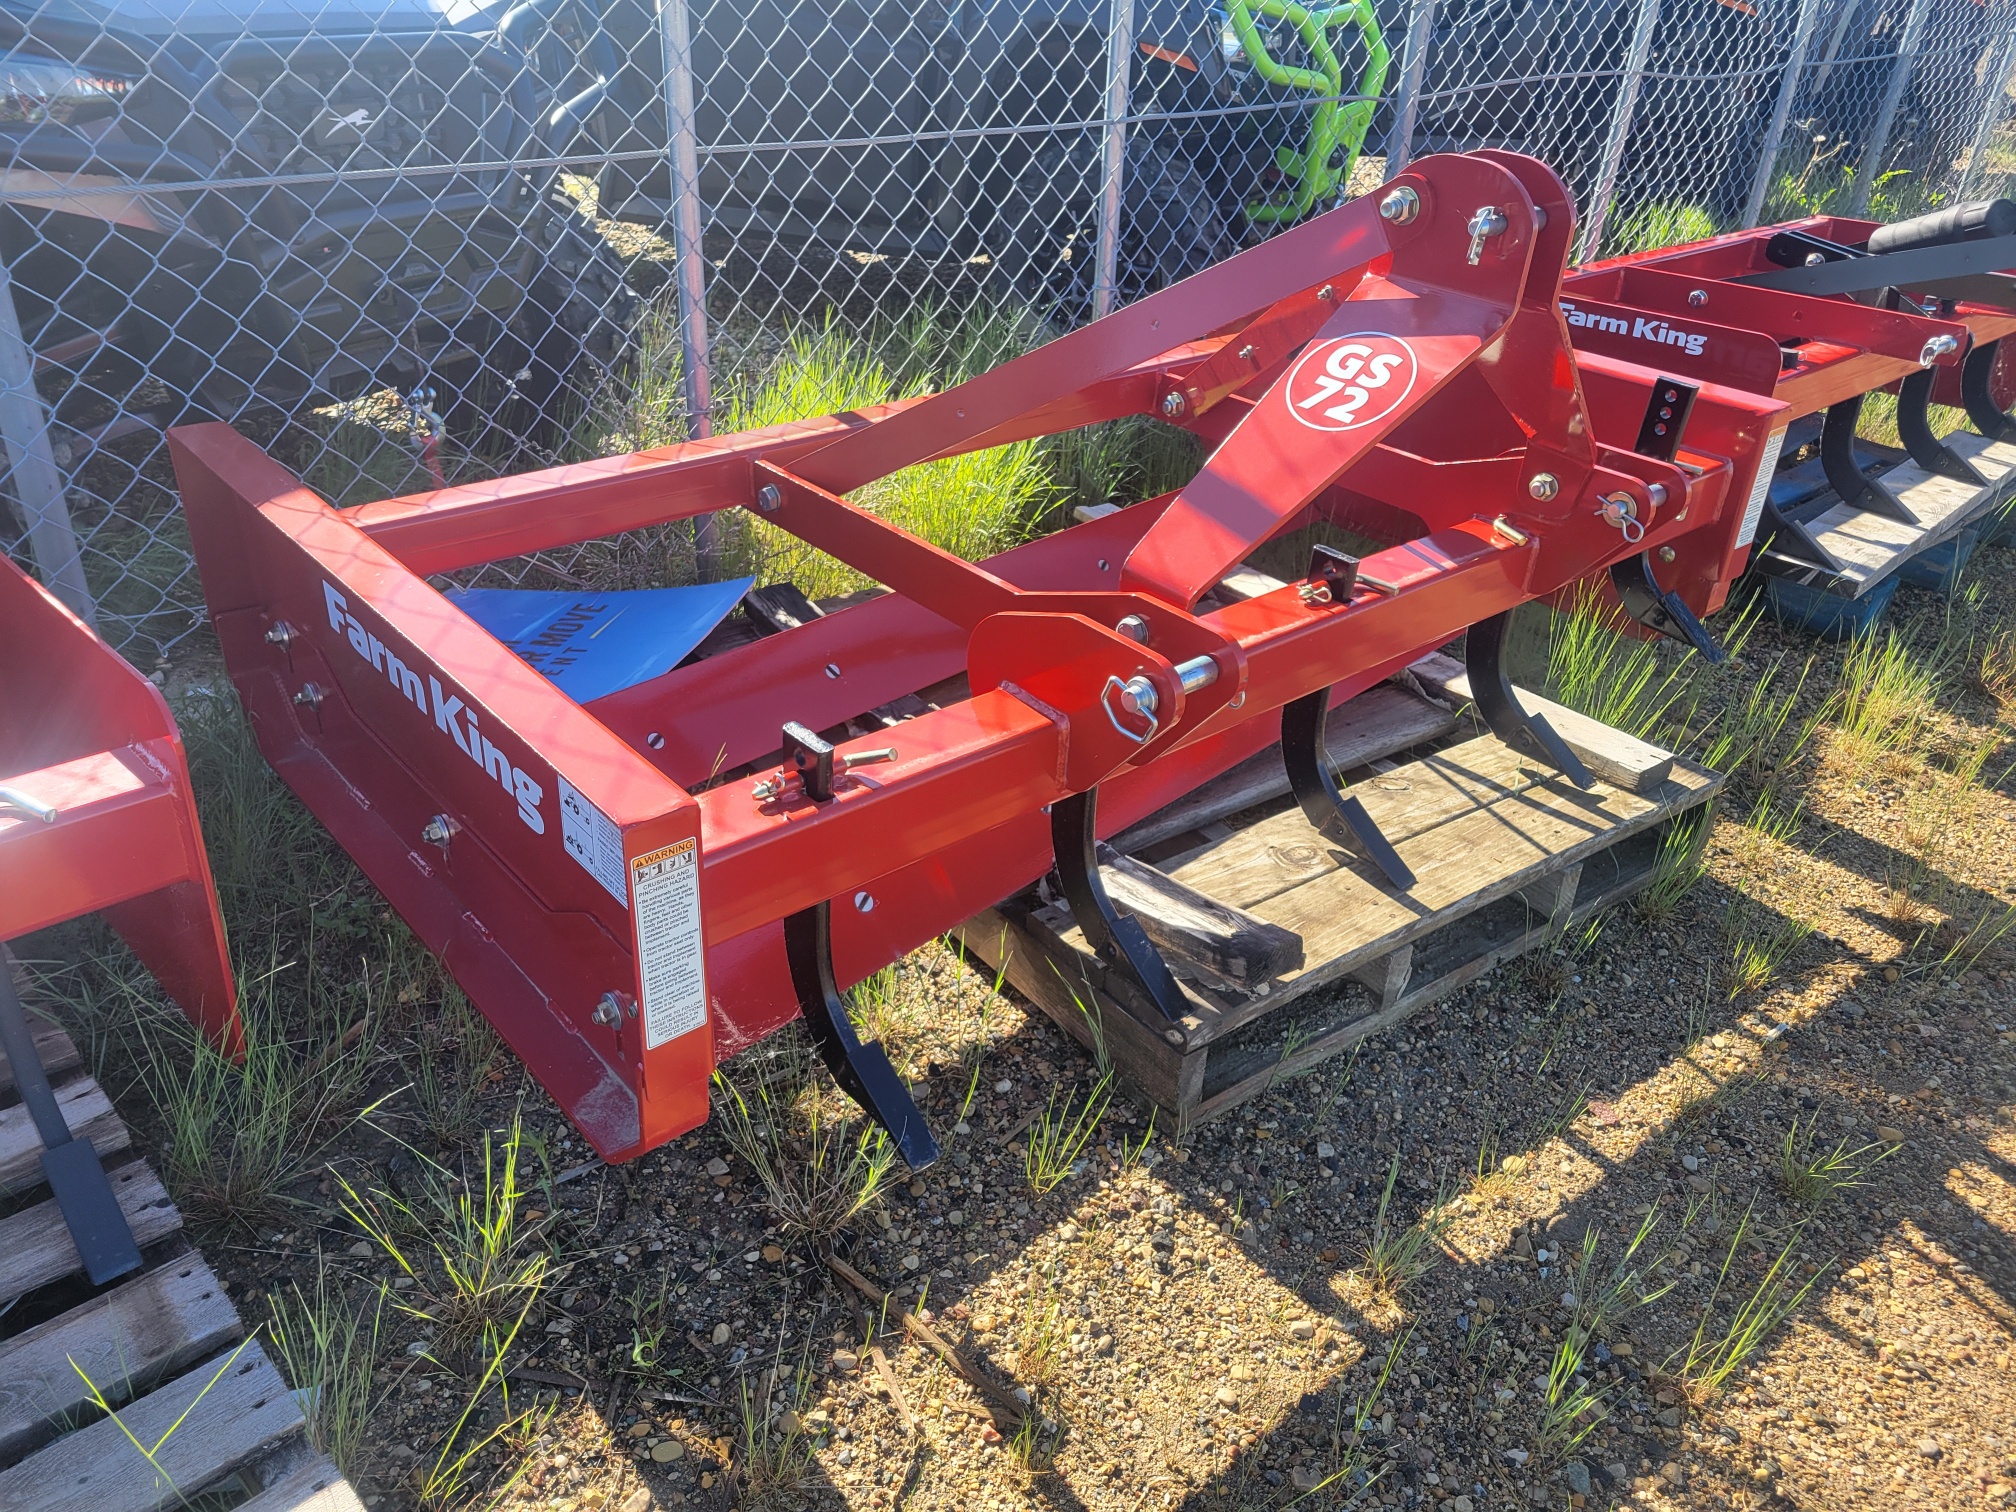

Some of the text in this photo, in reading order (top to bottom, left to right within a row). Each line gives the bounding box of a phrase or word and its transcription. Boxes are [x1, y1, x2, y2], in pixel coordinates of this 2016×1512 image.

[1559, 302, 1708, 356] Farm King
[1325, 344, 1404, 389] GS
[1296, 374, 1369, 424] 72
[529, 603, 609, 648] MOVE
[322, 579, 544, 835] Farm King
[644, 840, 692, 864] WARNING
[638, 872, 694, 898] PINCHING HAZARD
[642, 868, 689, 890] CRUSHING AND
[641, 886, 692, 909] handling various parts
[648, 889, 671, 901] extremely
[672, 882, 688, 892] careful
[643, 922, 655, 930] body
[656, 916, 668, 925] parts
[669, 911, 682, 919] could
[644, 924, 663, 934] crushed
[669, 914, 688, 925] pinched
[644, 929, 664, 939] between
[664, 922, 680, 931] tractor
[645, 927, 698, 952] Operate tractor controls
[646, 949, 657, 957] from
[657, 943, 673, 952] tractor
[662, 949, 675, 957] stand
[676, 941, 695, 952] between
[647, 960, 662, 969] tractor
[647, 966, 660, 974] when
[660, 959, 676, 968] tractor
[648, 973, 660, 981] Make
[672, 961, 689, 972] parking
[648, 977, 661, 986] brake
[667, 967, 686, 979] engaged
[649, 968, 696, 991] before going between
[649, 986, 664, 996] tractor
[650, 994, 663, 1003] Stand
[664, 989, 675, 997] clear
[681, 978, 699, 989] machine
[650, 1000, 662, 1008] while
[668, 988, 689, 1001] operation
[651, 1004, 663, 1012] when
[672, 994, 685, 1003] being
[685, 987, 699, 997] raised
[649, 1020, 666, 1030] THESE
[666, 1003, 703, 1023] INSTRUCTIONS
[650, 1012, 672, 1025] FAILURE
[681, 998, 702, 1011] FOLLOW
[654, 1022, 672, 1033] COULD
[673, 1012, 693, 1024] RESULT
[657, 1023, 679, 1037] SERIOUS
[680, 1015, 698, 1026] INJURY
